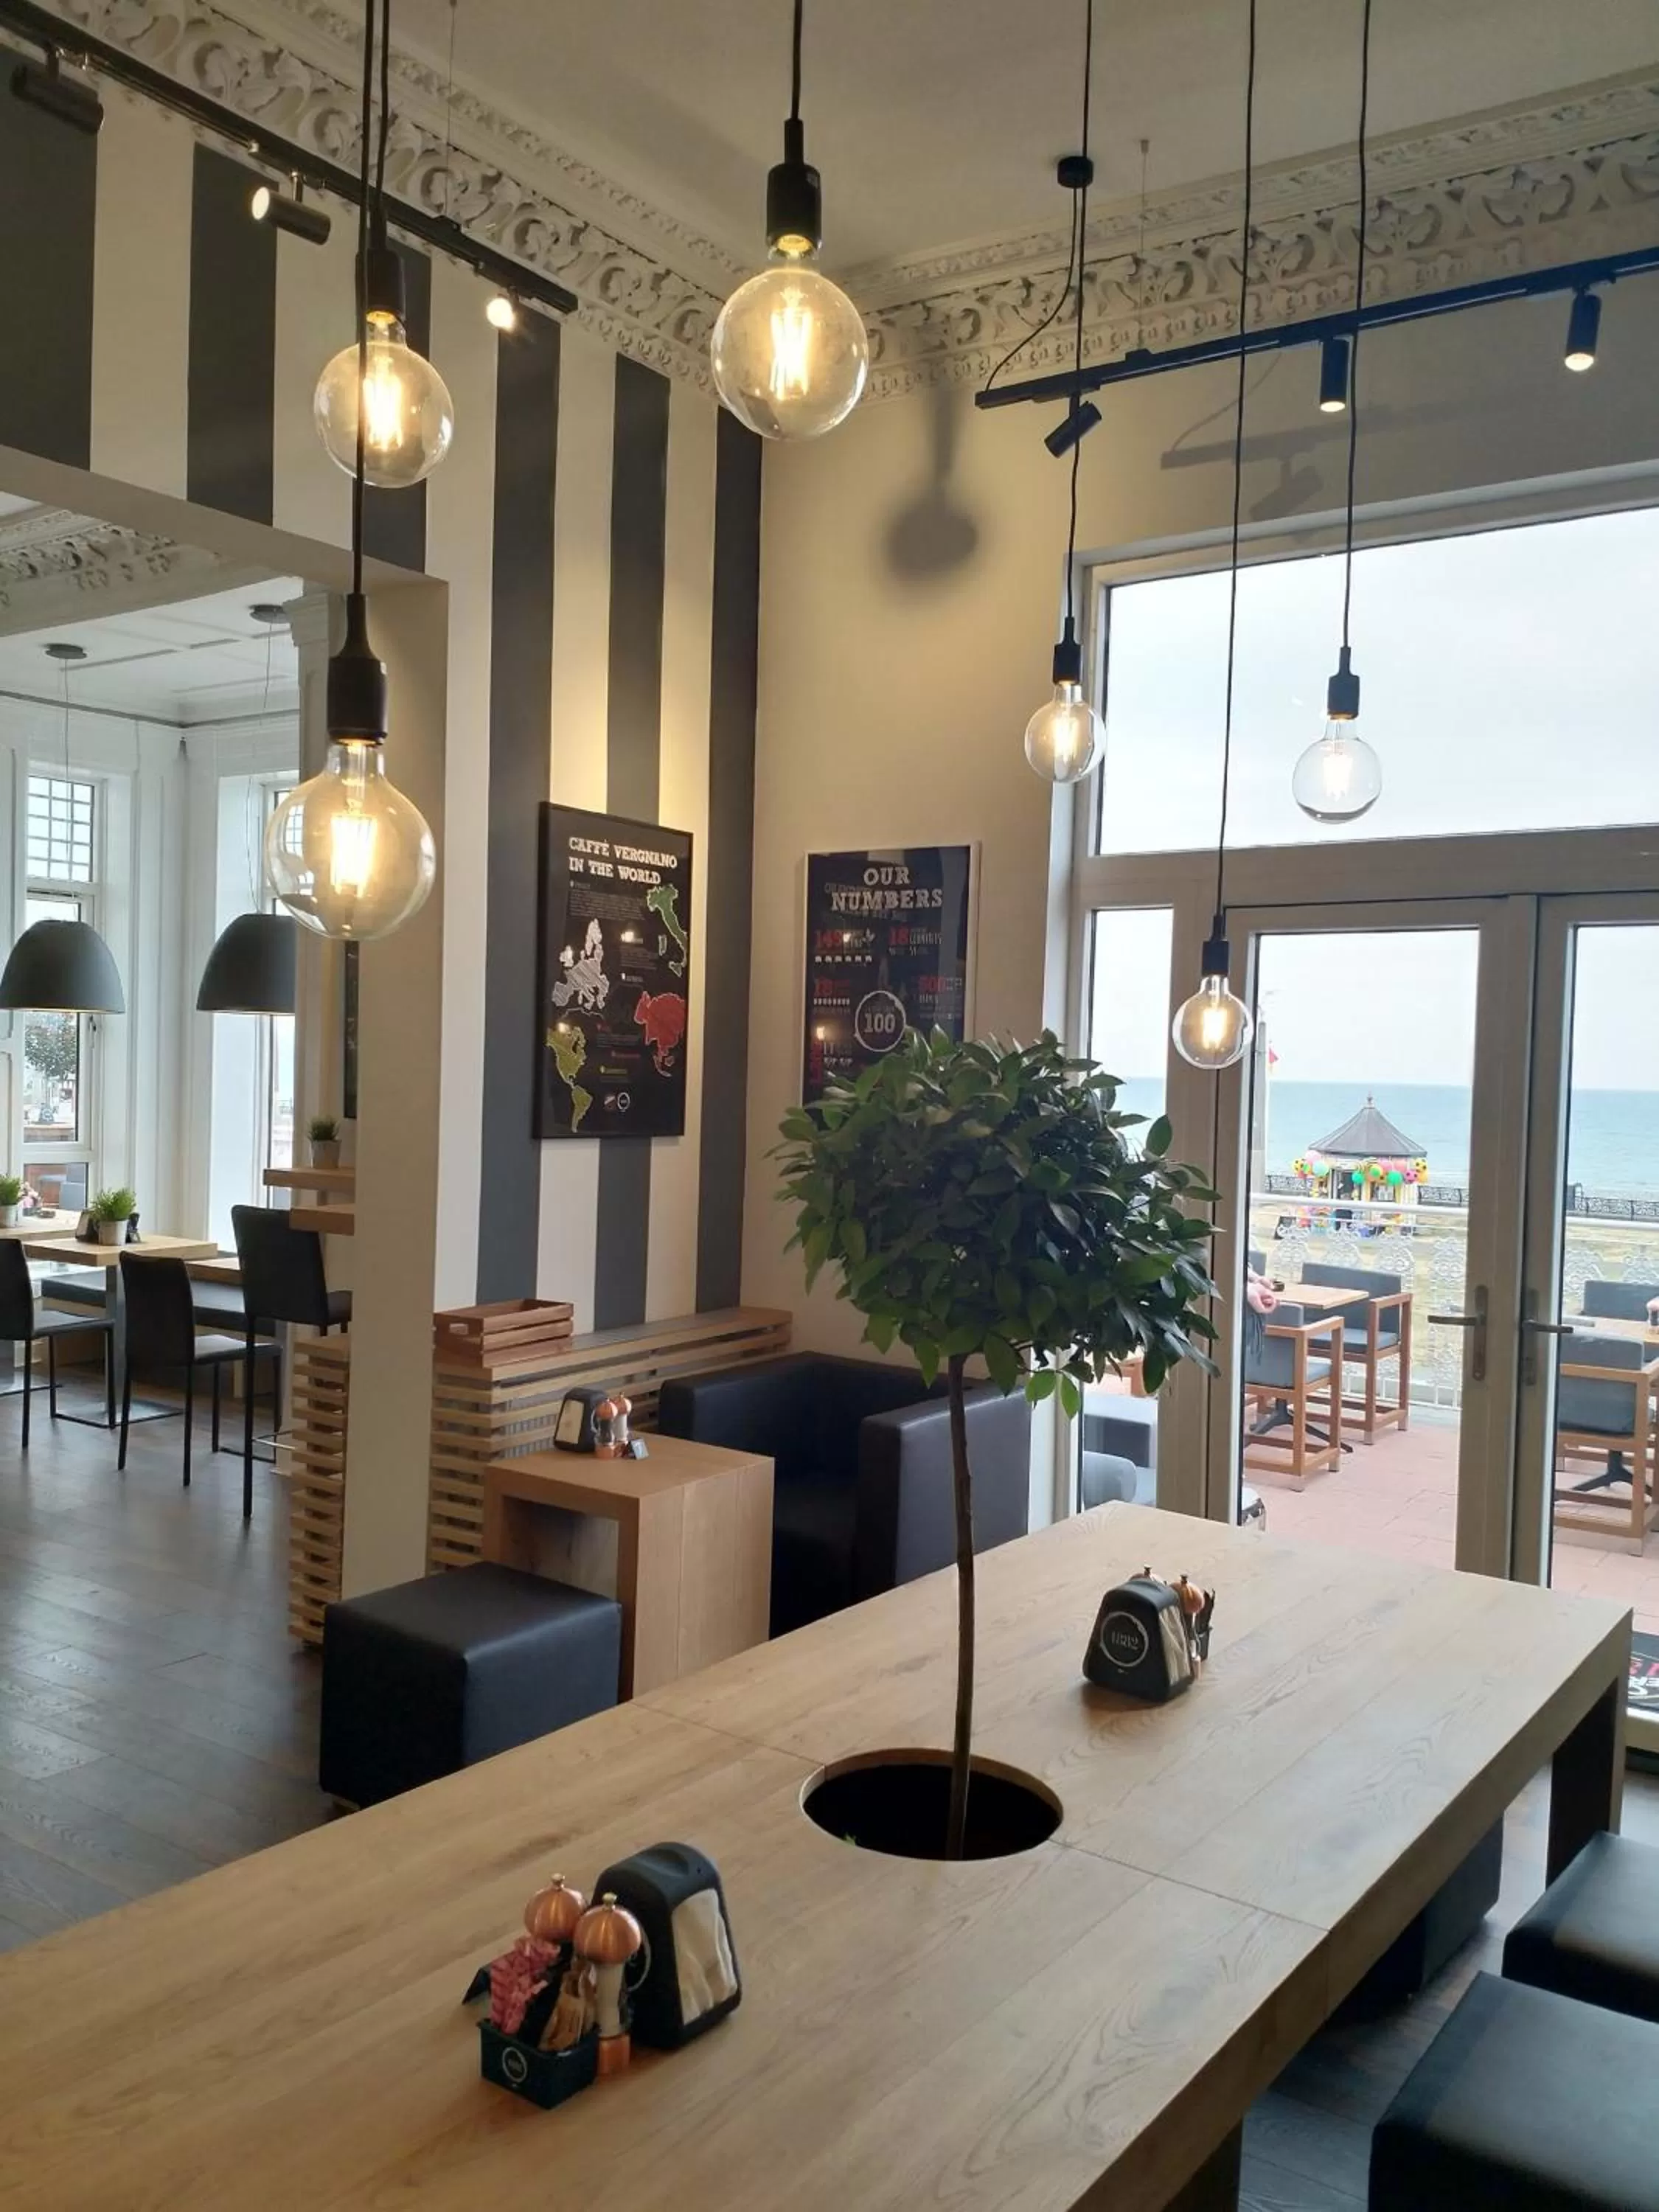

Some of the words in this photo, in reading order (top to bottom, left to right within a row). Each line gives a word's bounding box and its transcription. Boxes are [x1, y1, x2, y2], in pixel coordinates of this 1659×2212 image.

[613, 844, 678, 869] VERGNANO
[568, 856, 584, 872] IN
[588, 860, 614, 877] THE
[617, 865, 661, 884] WORLD
[863, 866, 911, 886] OUR
[831, 888, 943, 911] NUMBERS
[864, 1012, 896, 1034] 100
